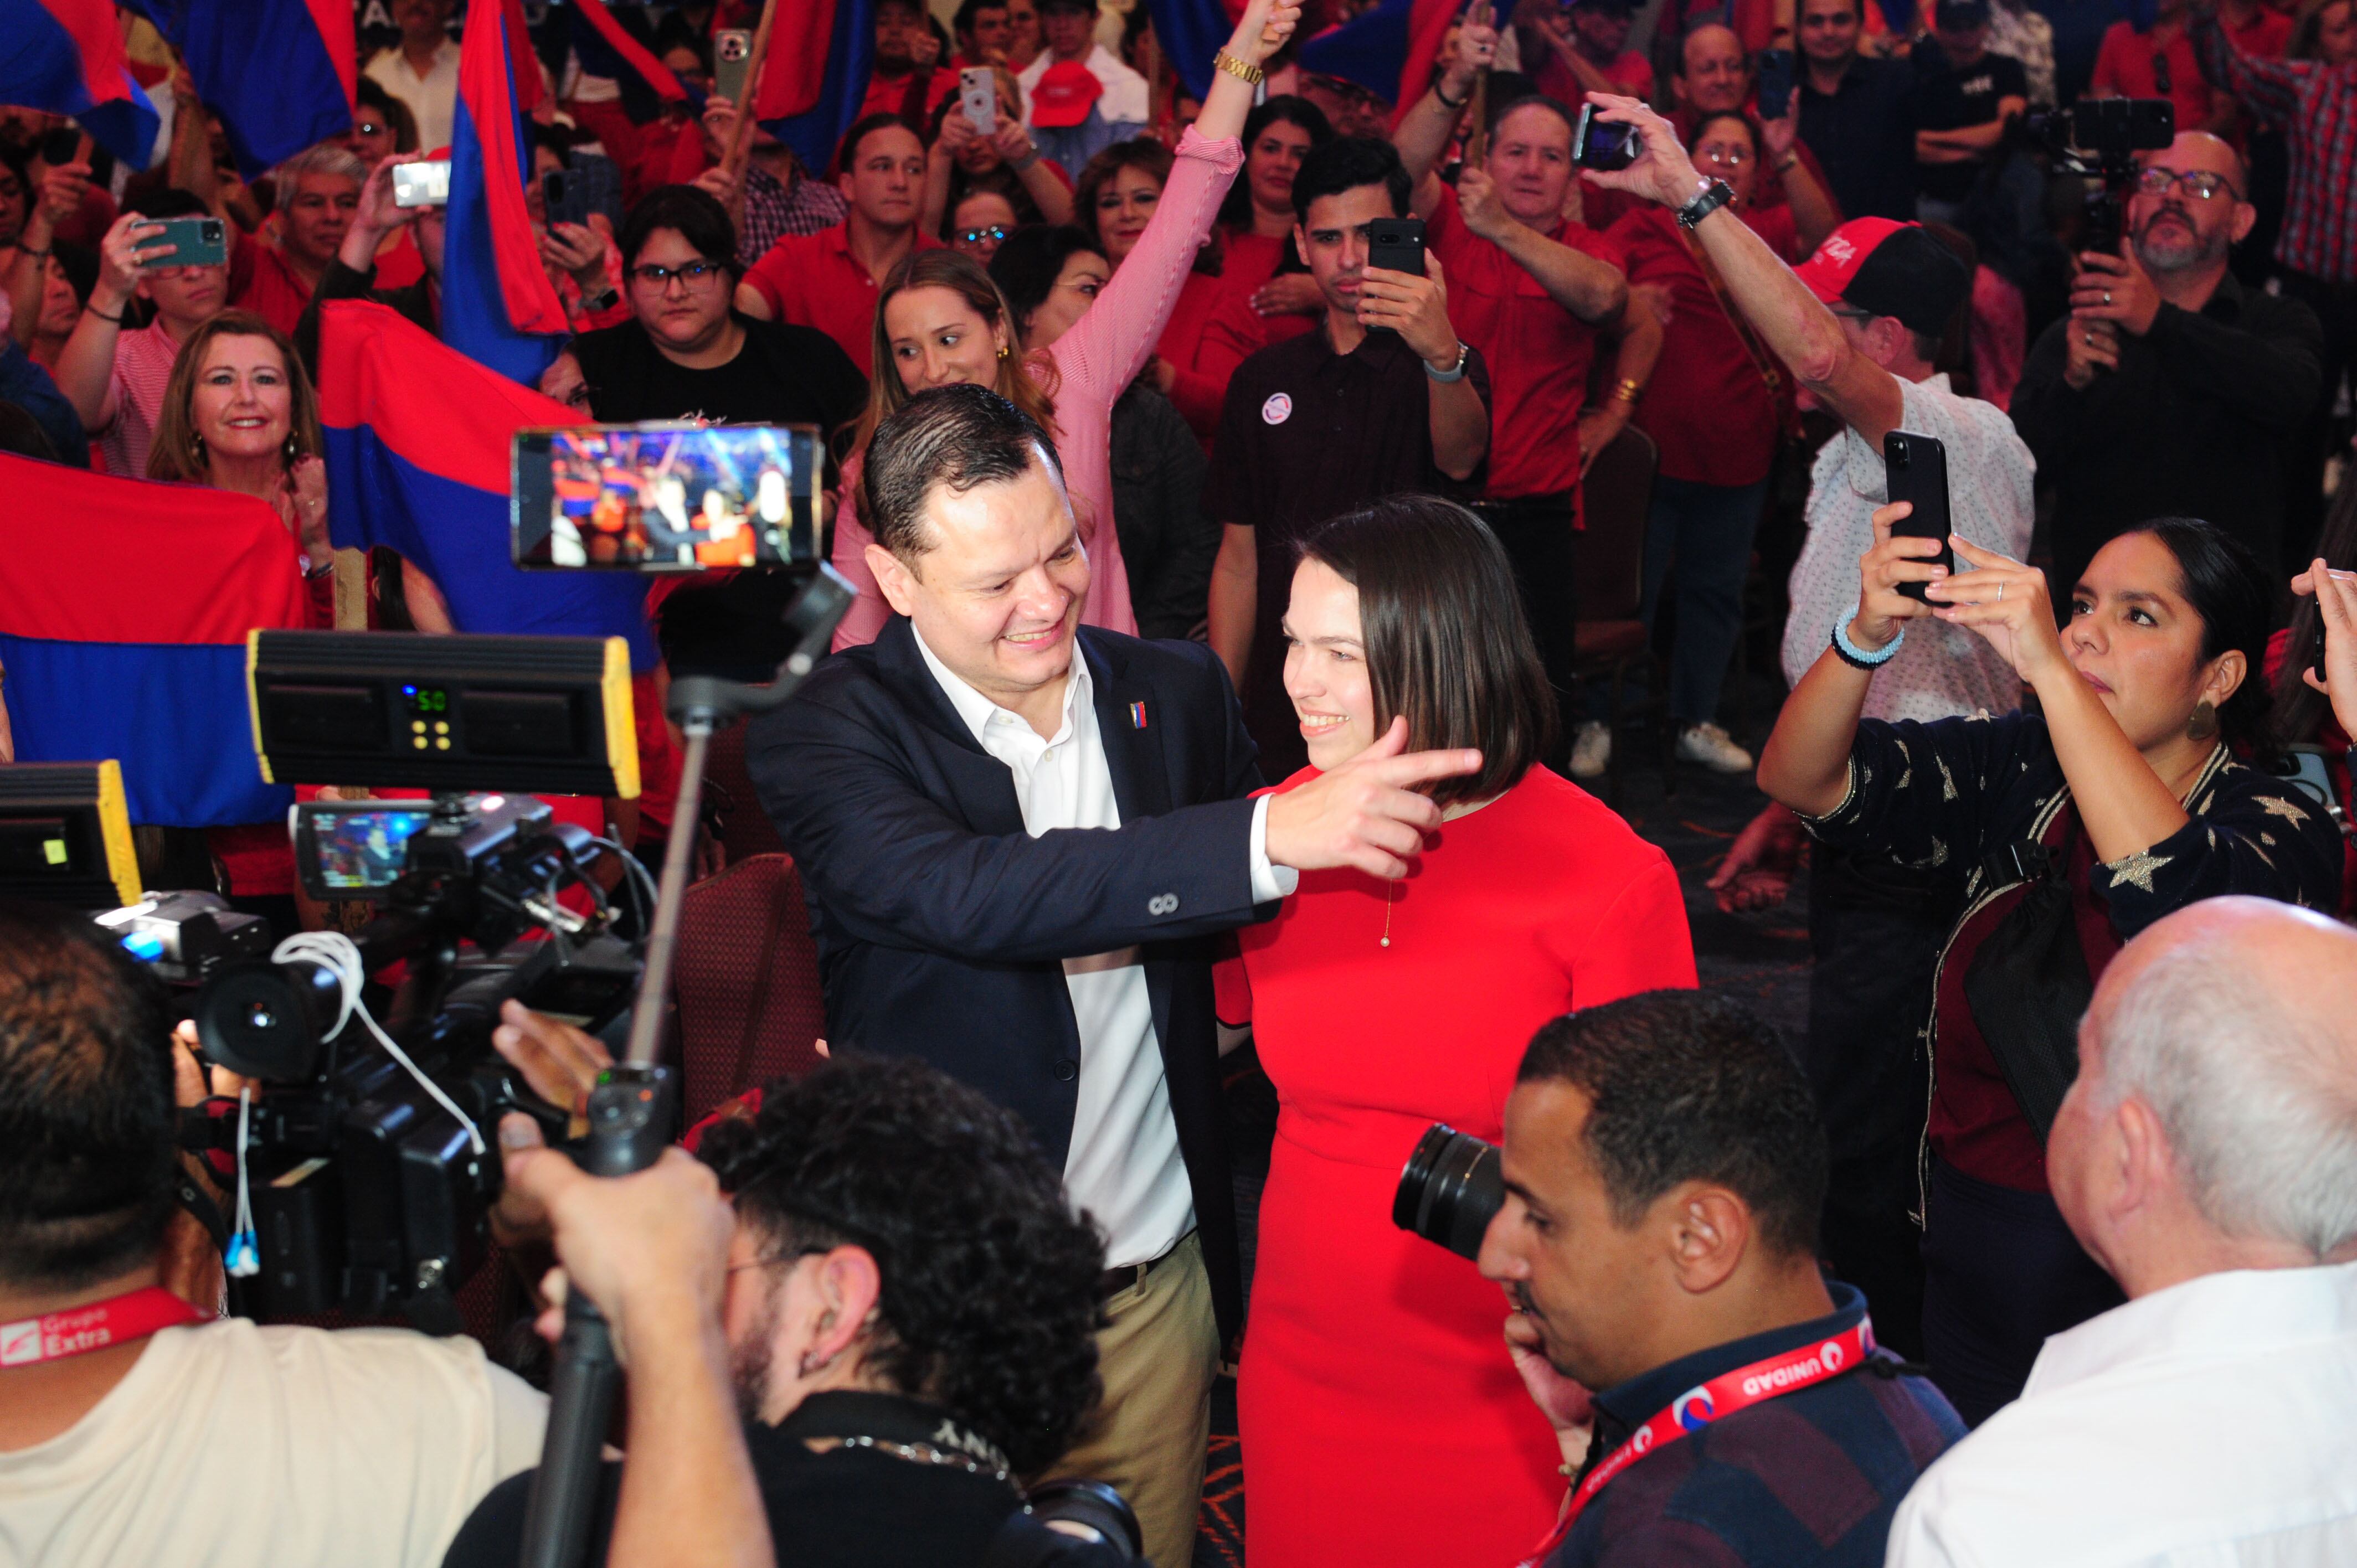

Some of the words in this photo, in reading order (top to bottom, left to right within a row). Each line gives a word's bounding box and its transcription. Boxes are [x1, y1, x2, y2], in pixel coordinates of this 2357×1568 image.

[44, 1307, 109, 1332] Grupo
[45, 1327, 111, 1356] Extra
[1742, 1358, 1823, 1396] UNIDAD
